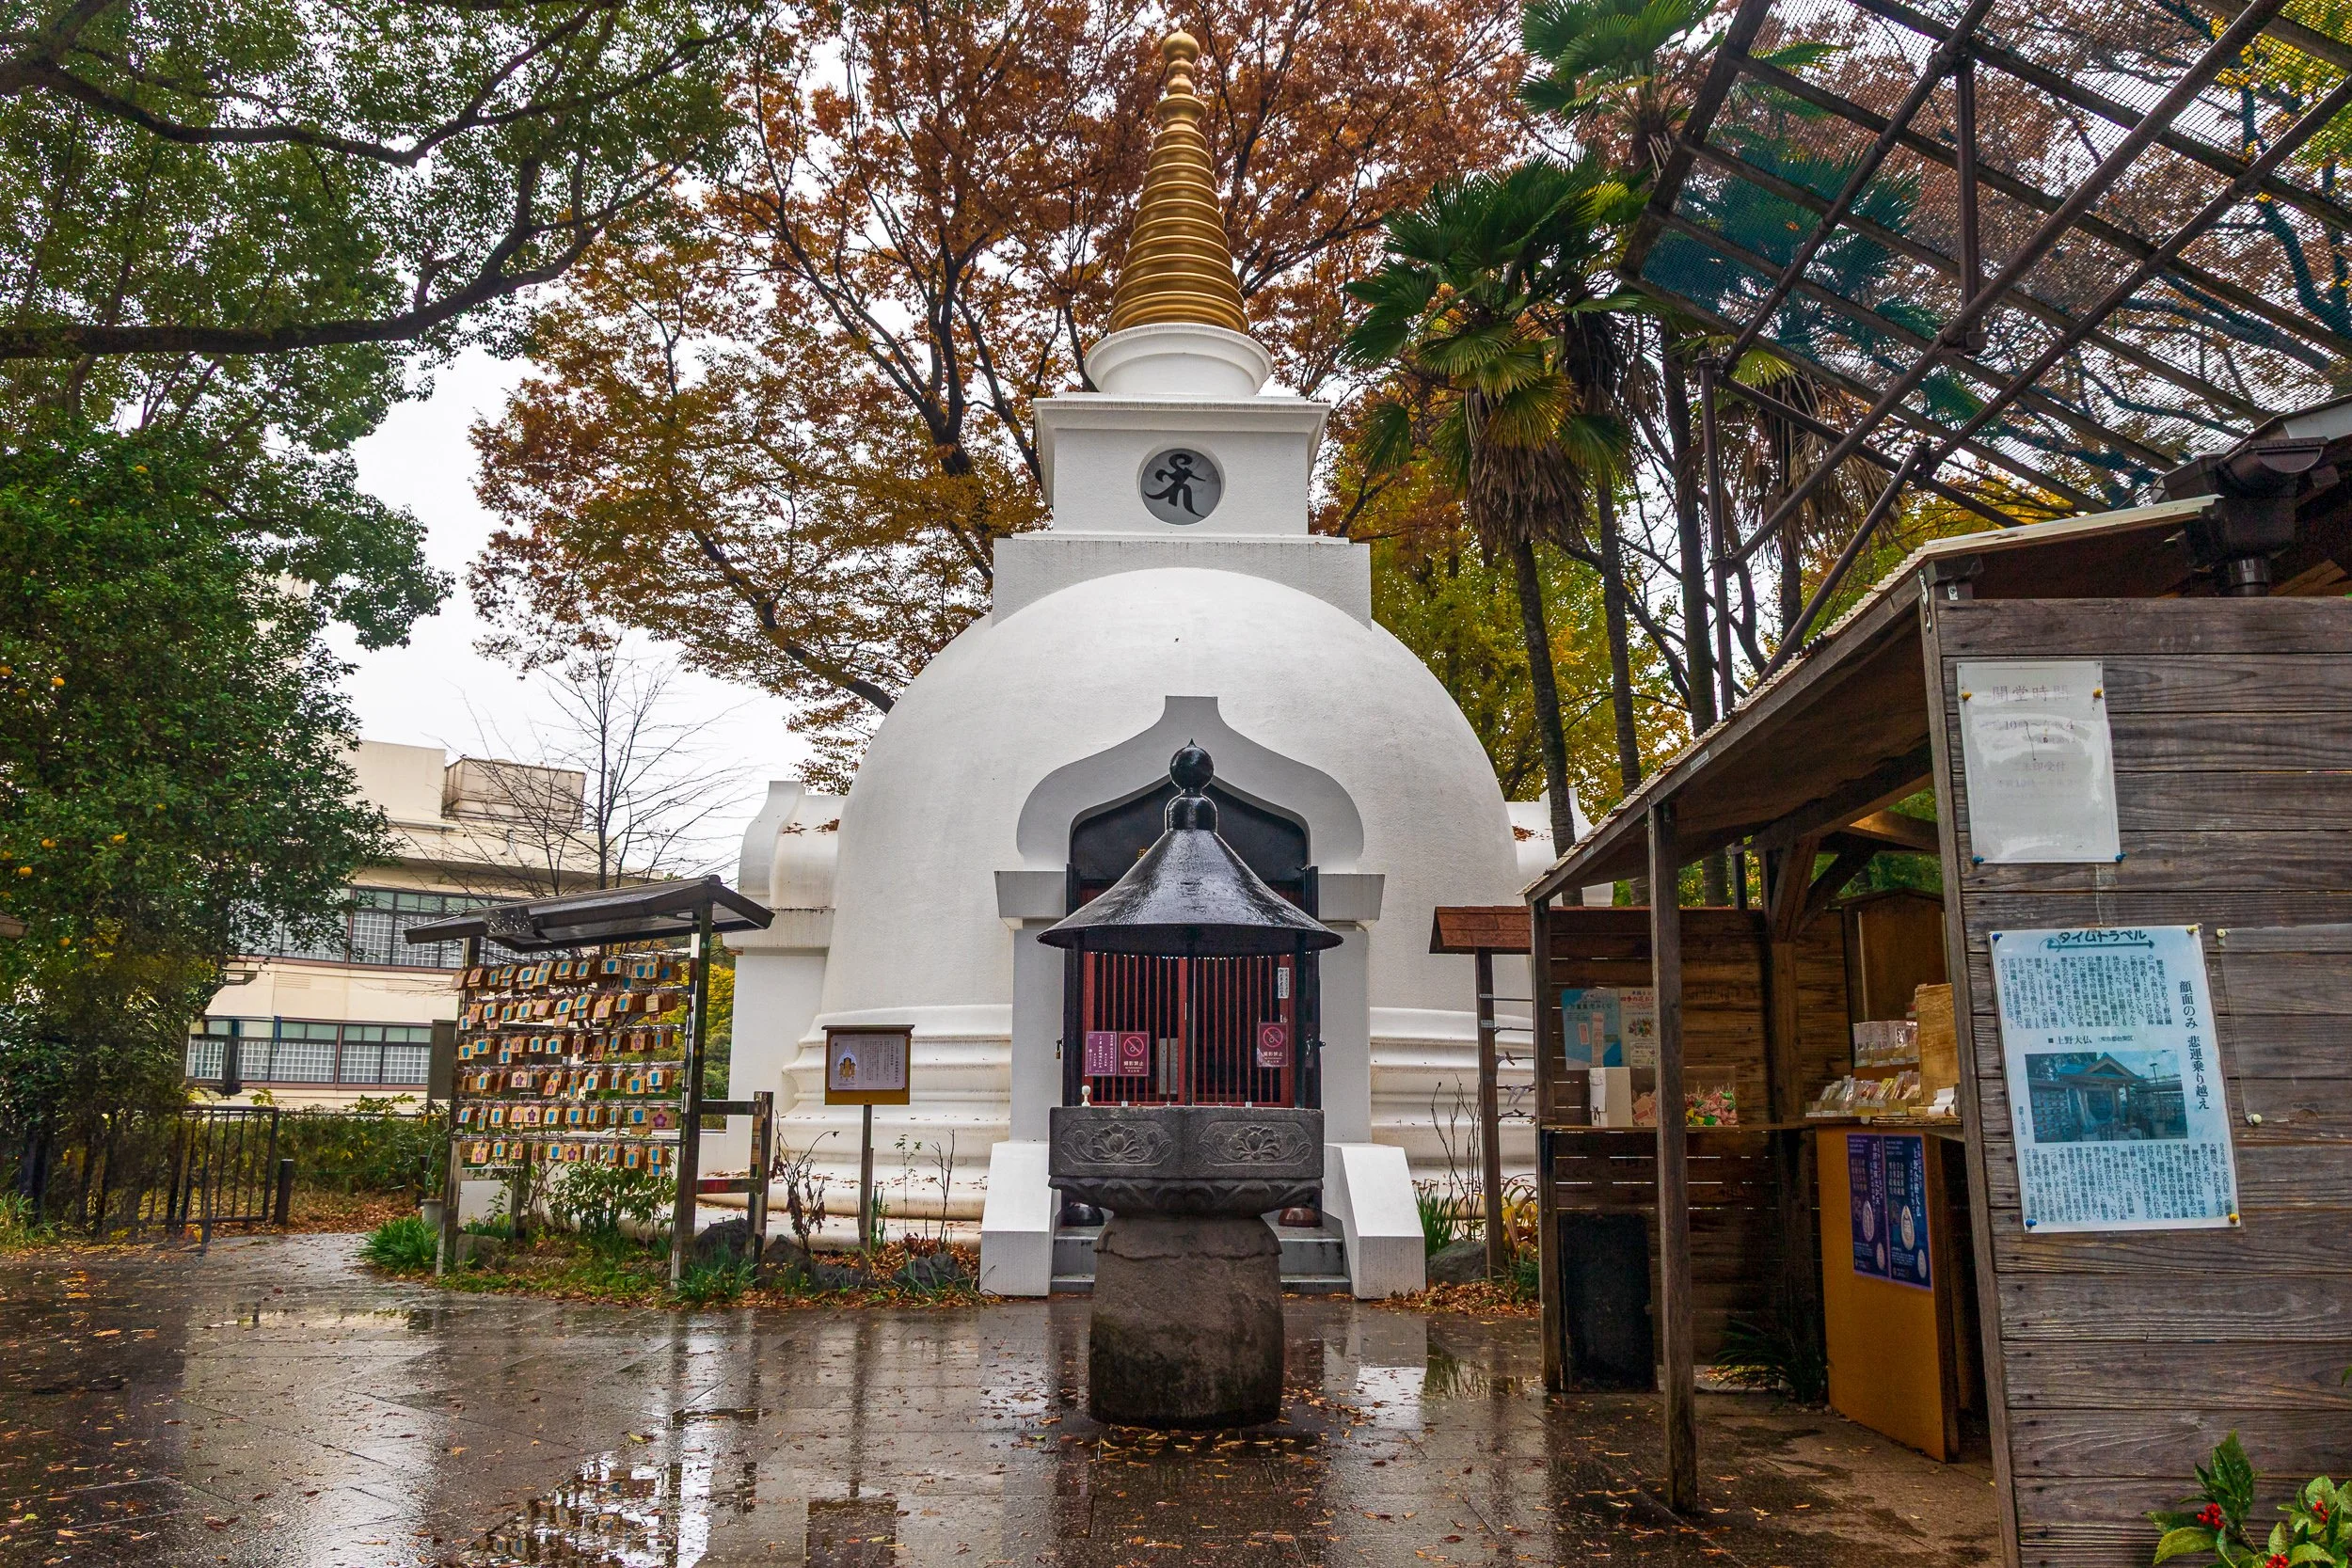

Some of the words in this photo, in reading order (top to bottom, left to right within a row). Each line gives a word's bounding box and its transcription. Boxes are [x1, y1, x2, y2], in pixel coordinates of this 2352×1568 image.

[1993, 685, 2070, 702] 開堂時間
[2058, 929, 2147, 944] タイムトラベル
[2179, 980, 2199, 1029] 顔面のみ
[2058, 1035, 2092, 1045] 上野大仏
[2187, 1036, 2210, 1110] 悲運乗り越え
